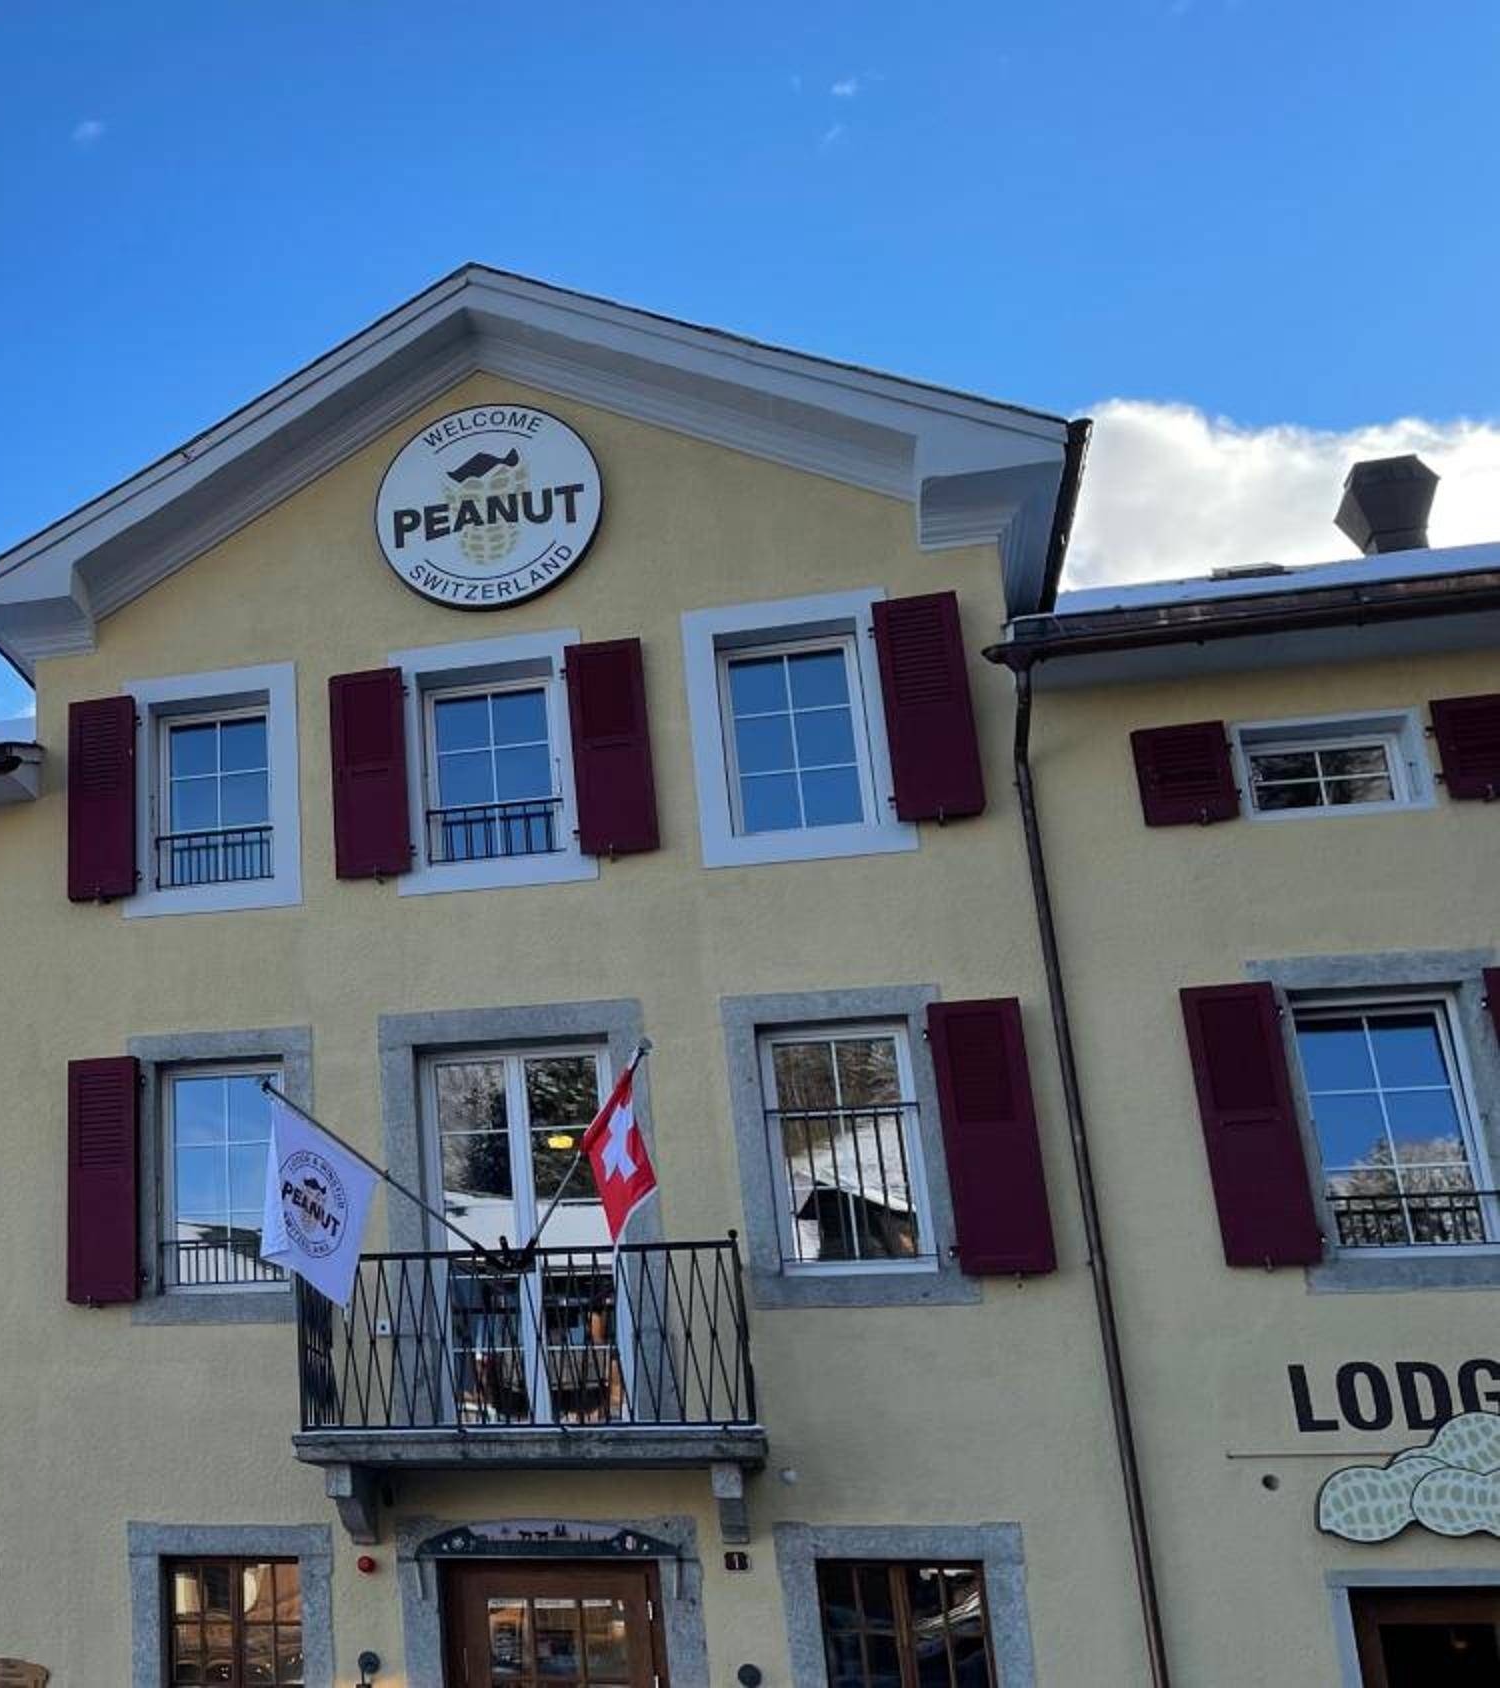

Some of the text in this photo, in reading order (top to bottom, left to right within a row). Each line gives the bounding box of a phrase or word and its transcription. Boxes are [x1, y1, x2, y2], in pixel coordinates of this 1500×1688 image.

[423, 411, 544, 448] WELCOME
[393, 483, 585, 549] PEANUT
[409, 544, 574, 600] SWITZERLAND
[282, 1180, 340, 1236] PEANUT
